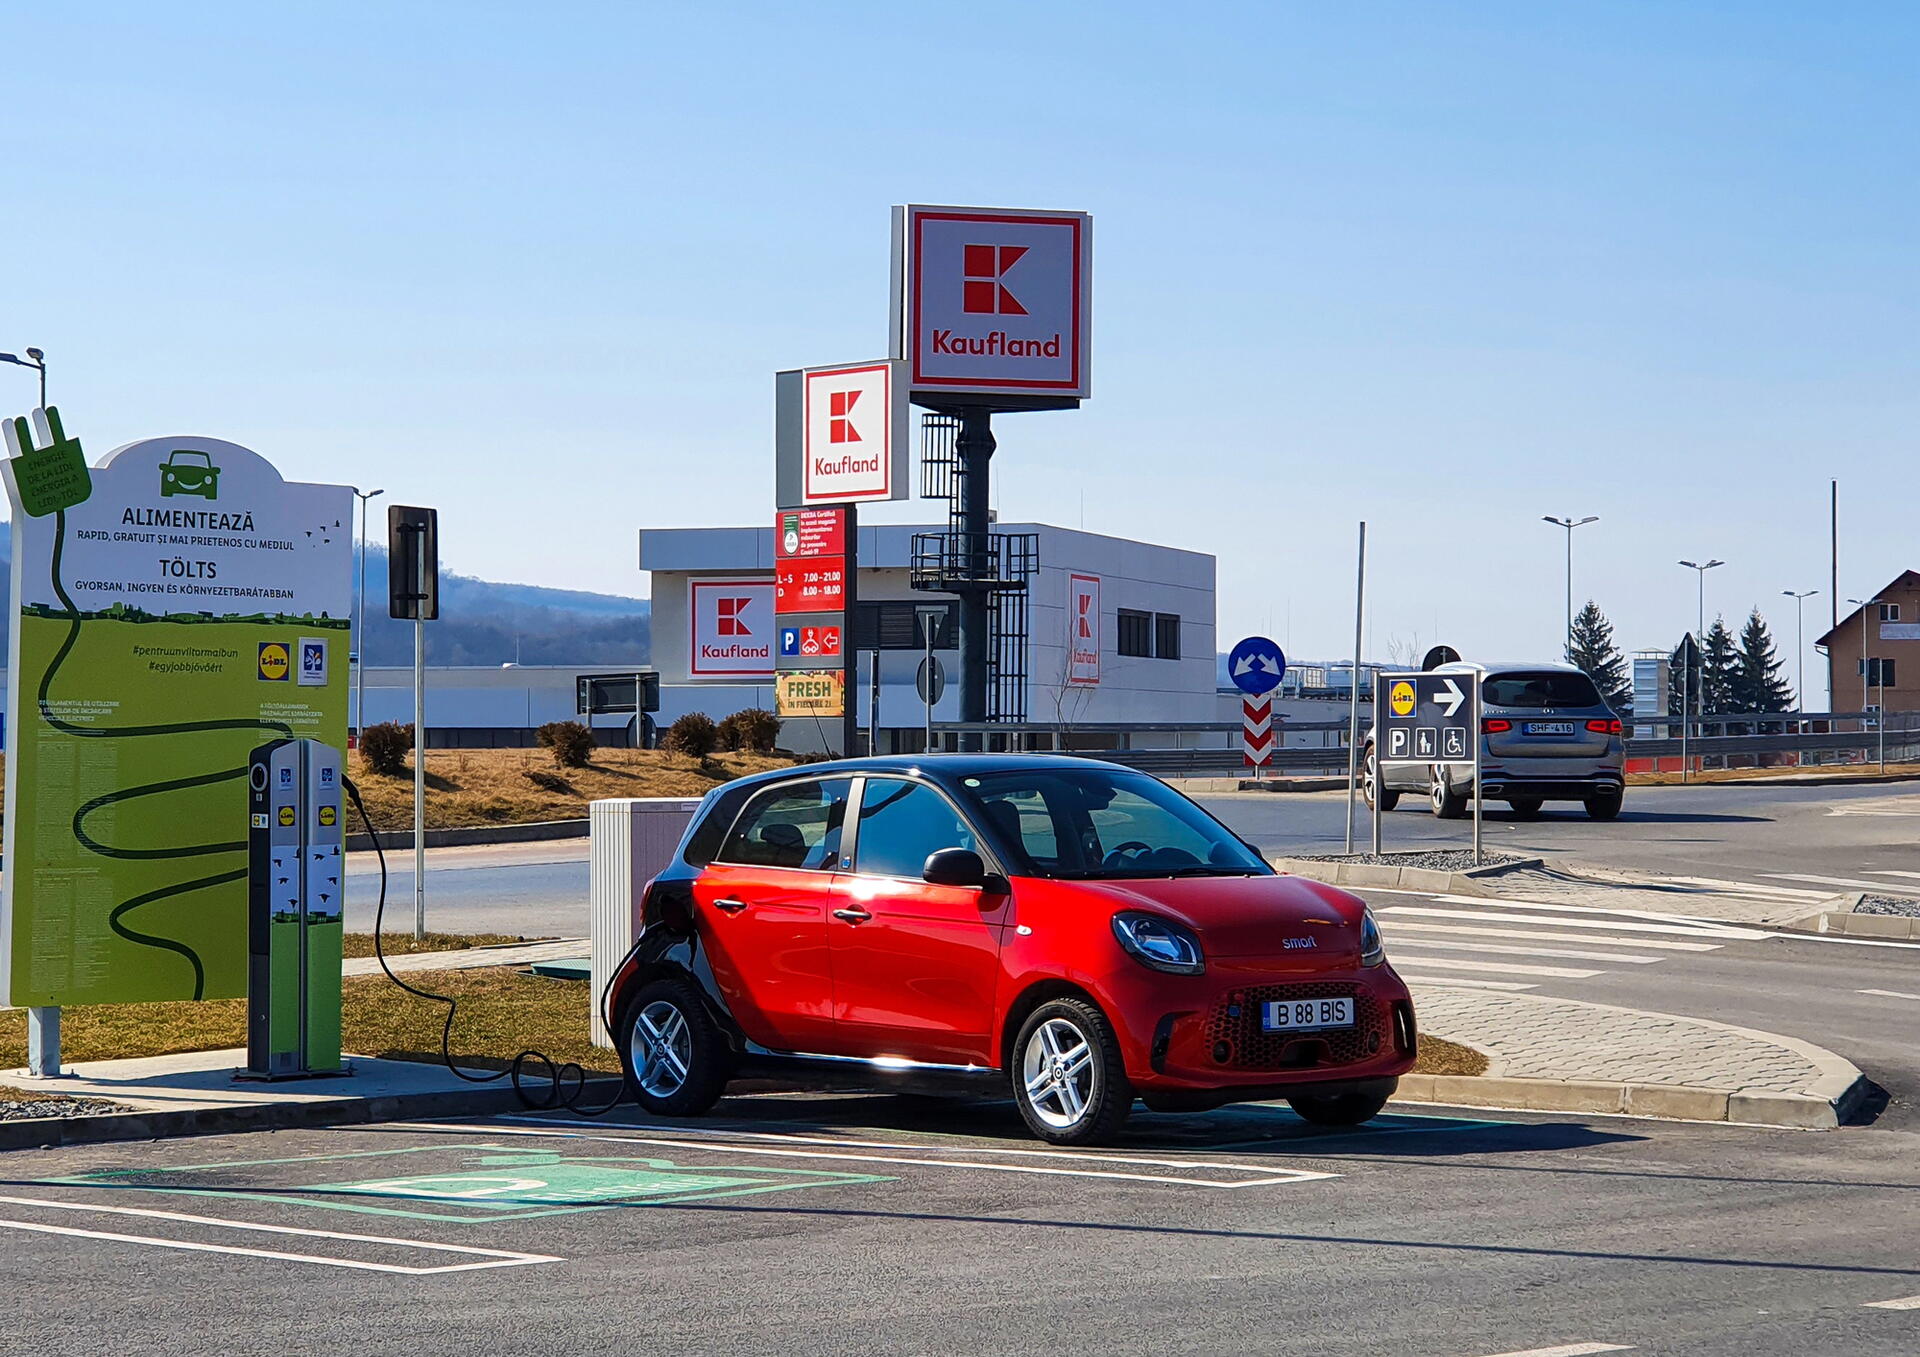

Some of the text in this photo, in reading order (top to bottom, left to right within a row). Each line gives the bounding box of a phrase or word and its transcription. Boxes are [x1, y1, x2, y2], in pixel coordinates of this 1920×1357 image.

[932, 329, 1060, 358] Kaufland
[815, 453, 879, 476] Kaufland
[121, 507, 255, 532] ALIMENTEAZĂ
[77, 530, 111, 542] RAPID,
[113, 532, 156, 543] GRATUIT
[169, 536, 189, 546] MAI
[191, 537, 242, 549] PRIETENOS
[244, 539, 257, 549] CU
[259, 540, 295, 551] MEDIUL
[159, 556, 217, 579] TÖLTS
[75, 580, 294, 599] GYORSAN, INGYEN ÉS KÖRNYEZETBARÁTABBAN
[778, 588, 785, 597] D
[702, 644, 769, 658] Kaufland
[785, 632, 794, 651] P
[788, 681, 831, 697] FRESH
[1531, 723, 1572, 732] SHF-416
[1391, 730, 1405, 755] P
[1282, 935, 1317, 949] smart
[1278, 1000, 1346, 1025] B 88 BIS
